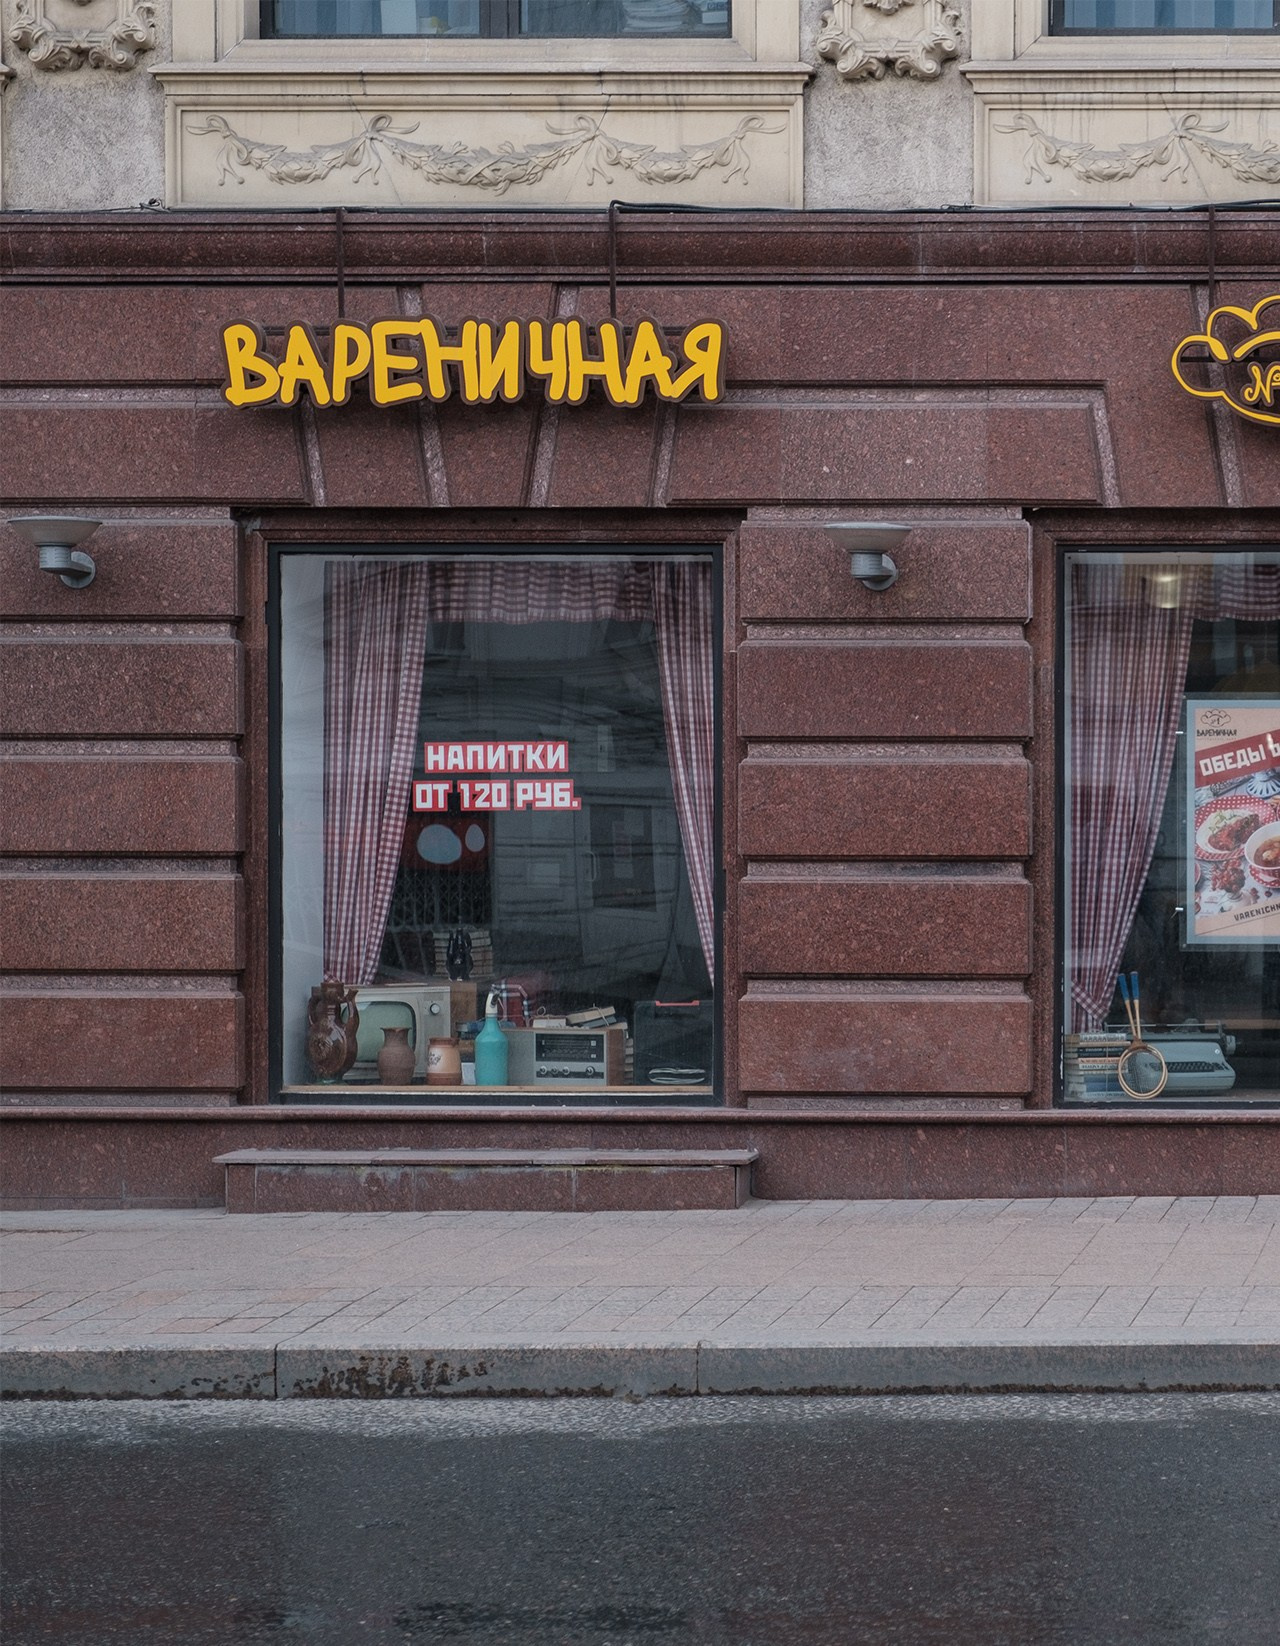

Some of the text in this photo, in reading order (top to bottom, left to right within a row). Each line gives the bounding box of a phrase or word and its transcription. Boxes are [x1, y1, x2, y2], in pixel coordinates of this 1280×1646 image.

[222, 317, 725, 406] ВАРЕНИЧНАЯ
[426, 743, 567, 771] НАПИТКИ
[1199, 743, 1266, 776] ОБЕДЫ
[415, 782, 579, 809] ОТ 120 РУБ.
